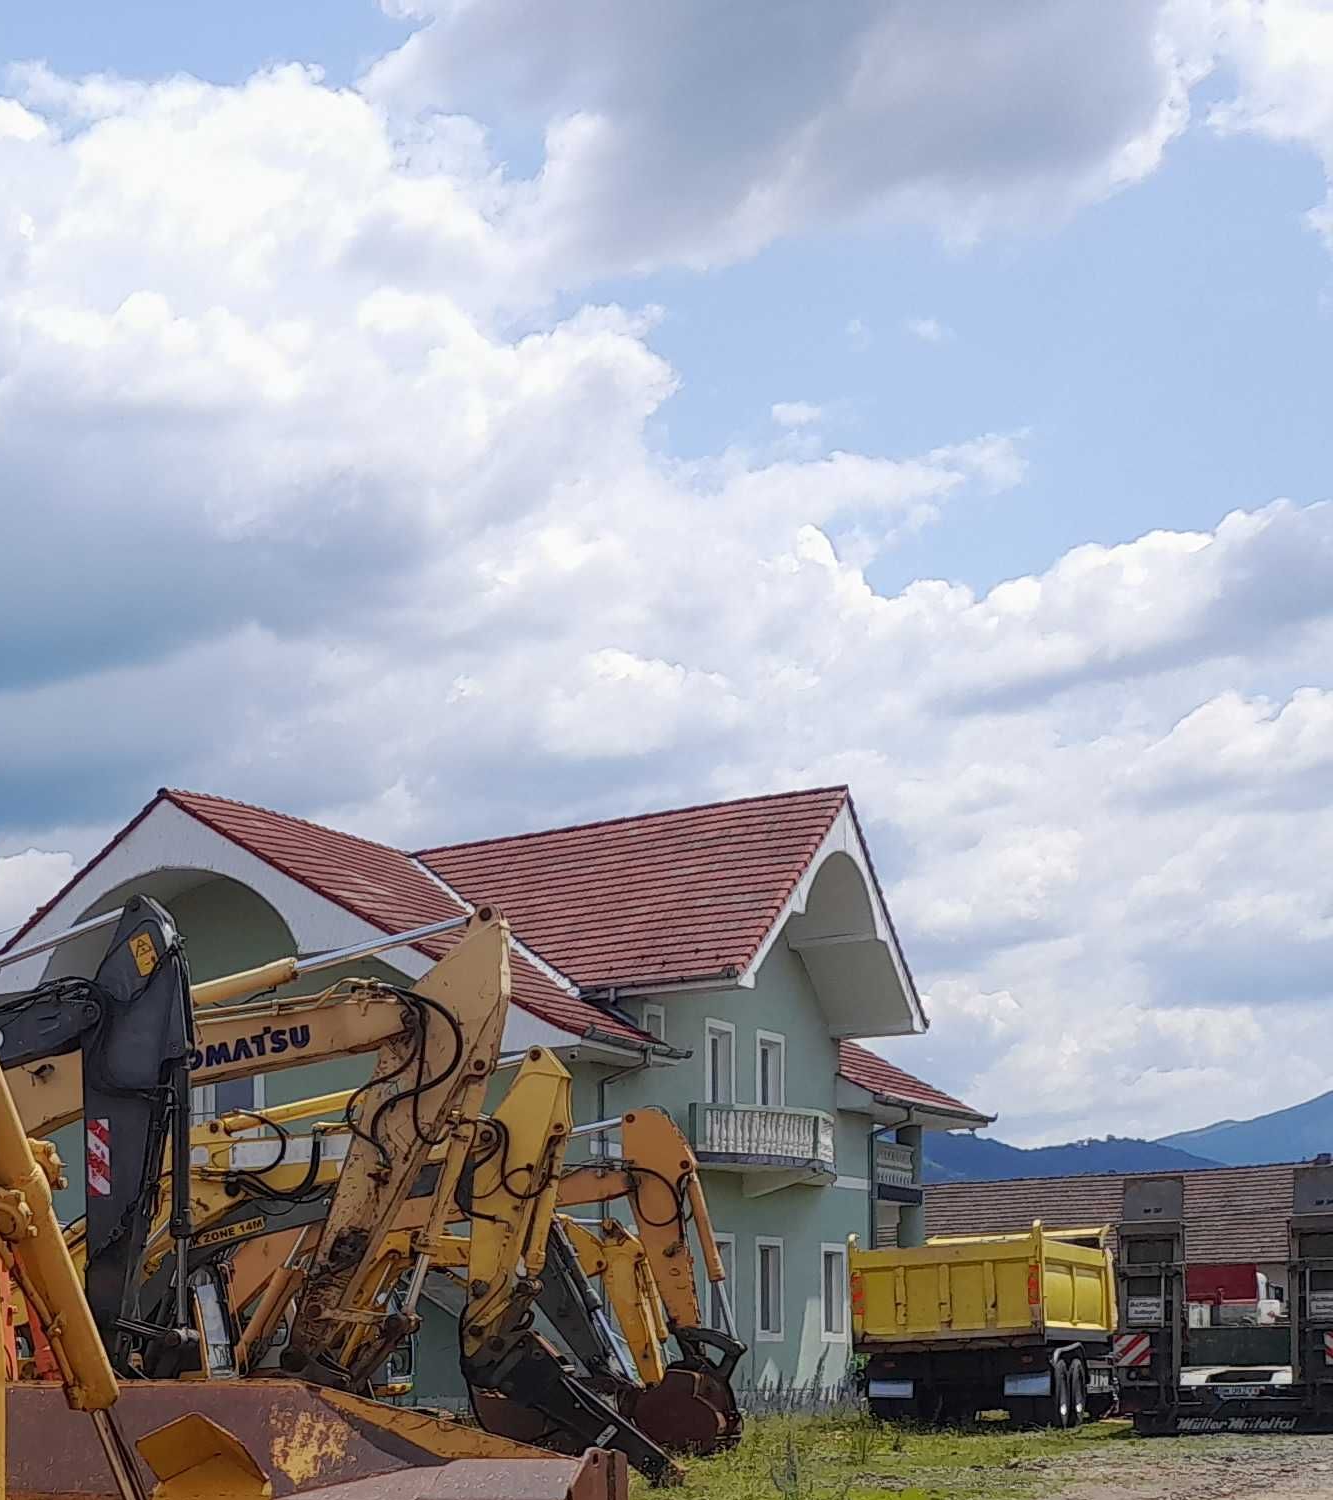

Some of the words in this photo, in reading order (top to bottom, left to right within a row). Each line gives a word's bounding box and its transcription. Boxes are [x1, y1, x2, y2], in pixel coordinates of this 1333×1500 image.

[188, 1025, 311, 1070] OMATSU
[203, 1228, 235, 1242] ZONE
[239, 1219, 263, 1233] 14M
[1176, 1417, 1227, 1430] Müller
